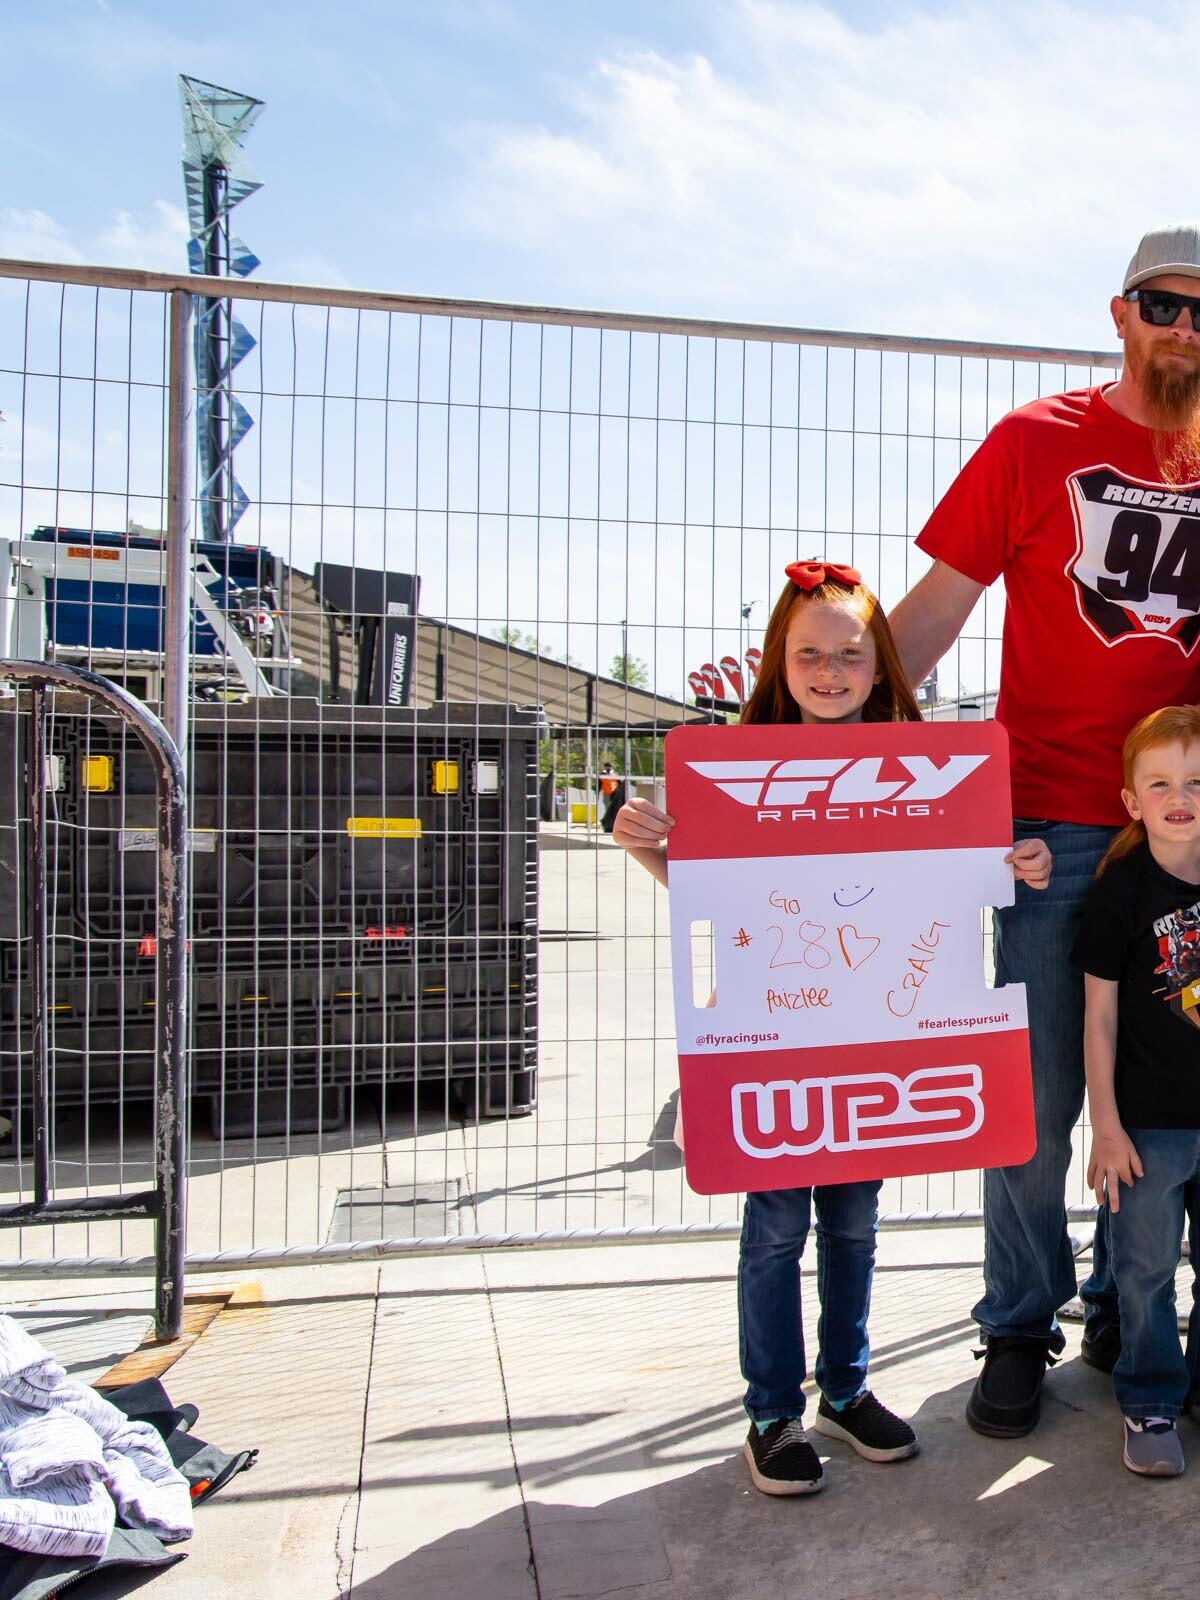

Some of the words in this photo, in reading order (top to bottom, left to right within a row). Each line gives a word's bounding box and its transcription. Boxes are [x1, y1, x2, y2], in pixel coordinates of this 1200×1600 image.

[1143, 613, 1172, 625] KR94
[388, 634, 408, 705] UNICARRIERS
[684, 755, 991, 806] FLY
[886, 921, 951, 1017] CRAIG
[695, 1031, 780, 1047] @flyracingusa
[917, 1012, 1010, 1030] #fearlesspursuit
[731, 1064, 984, 1159] WPS
